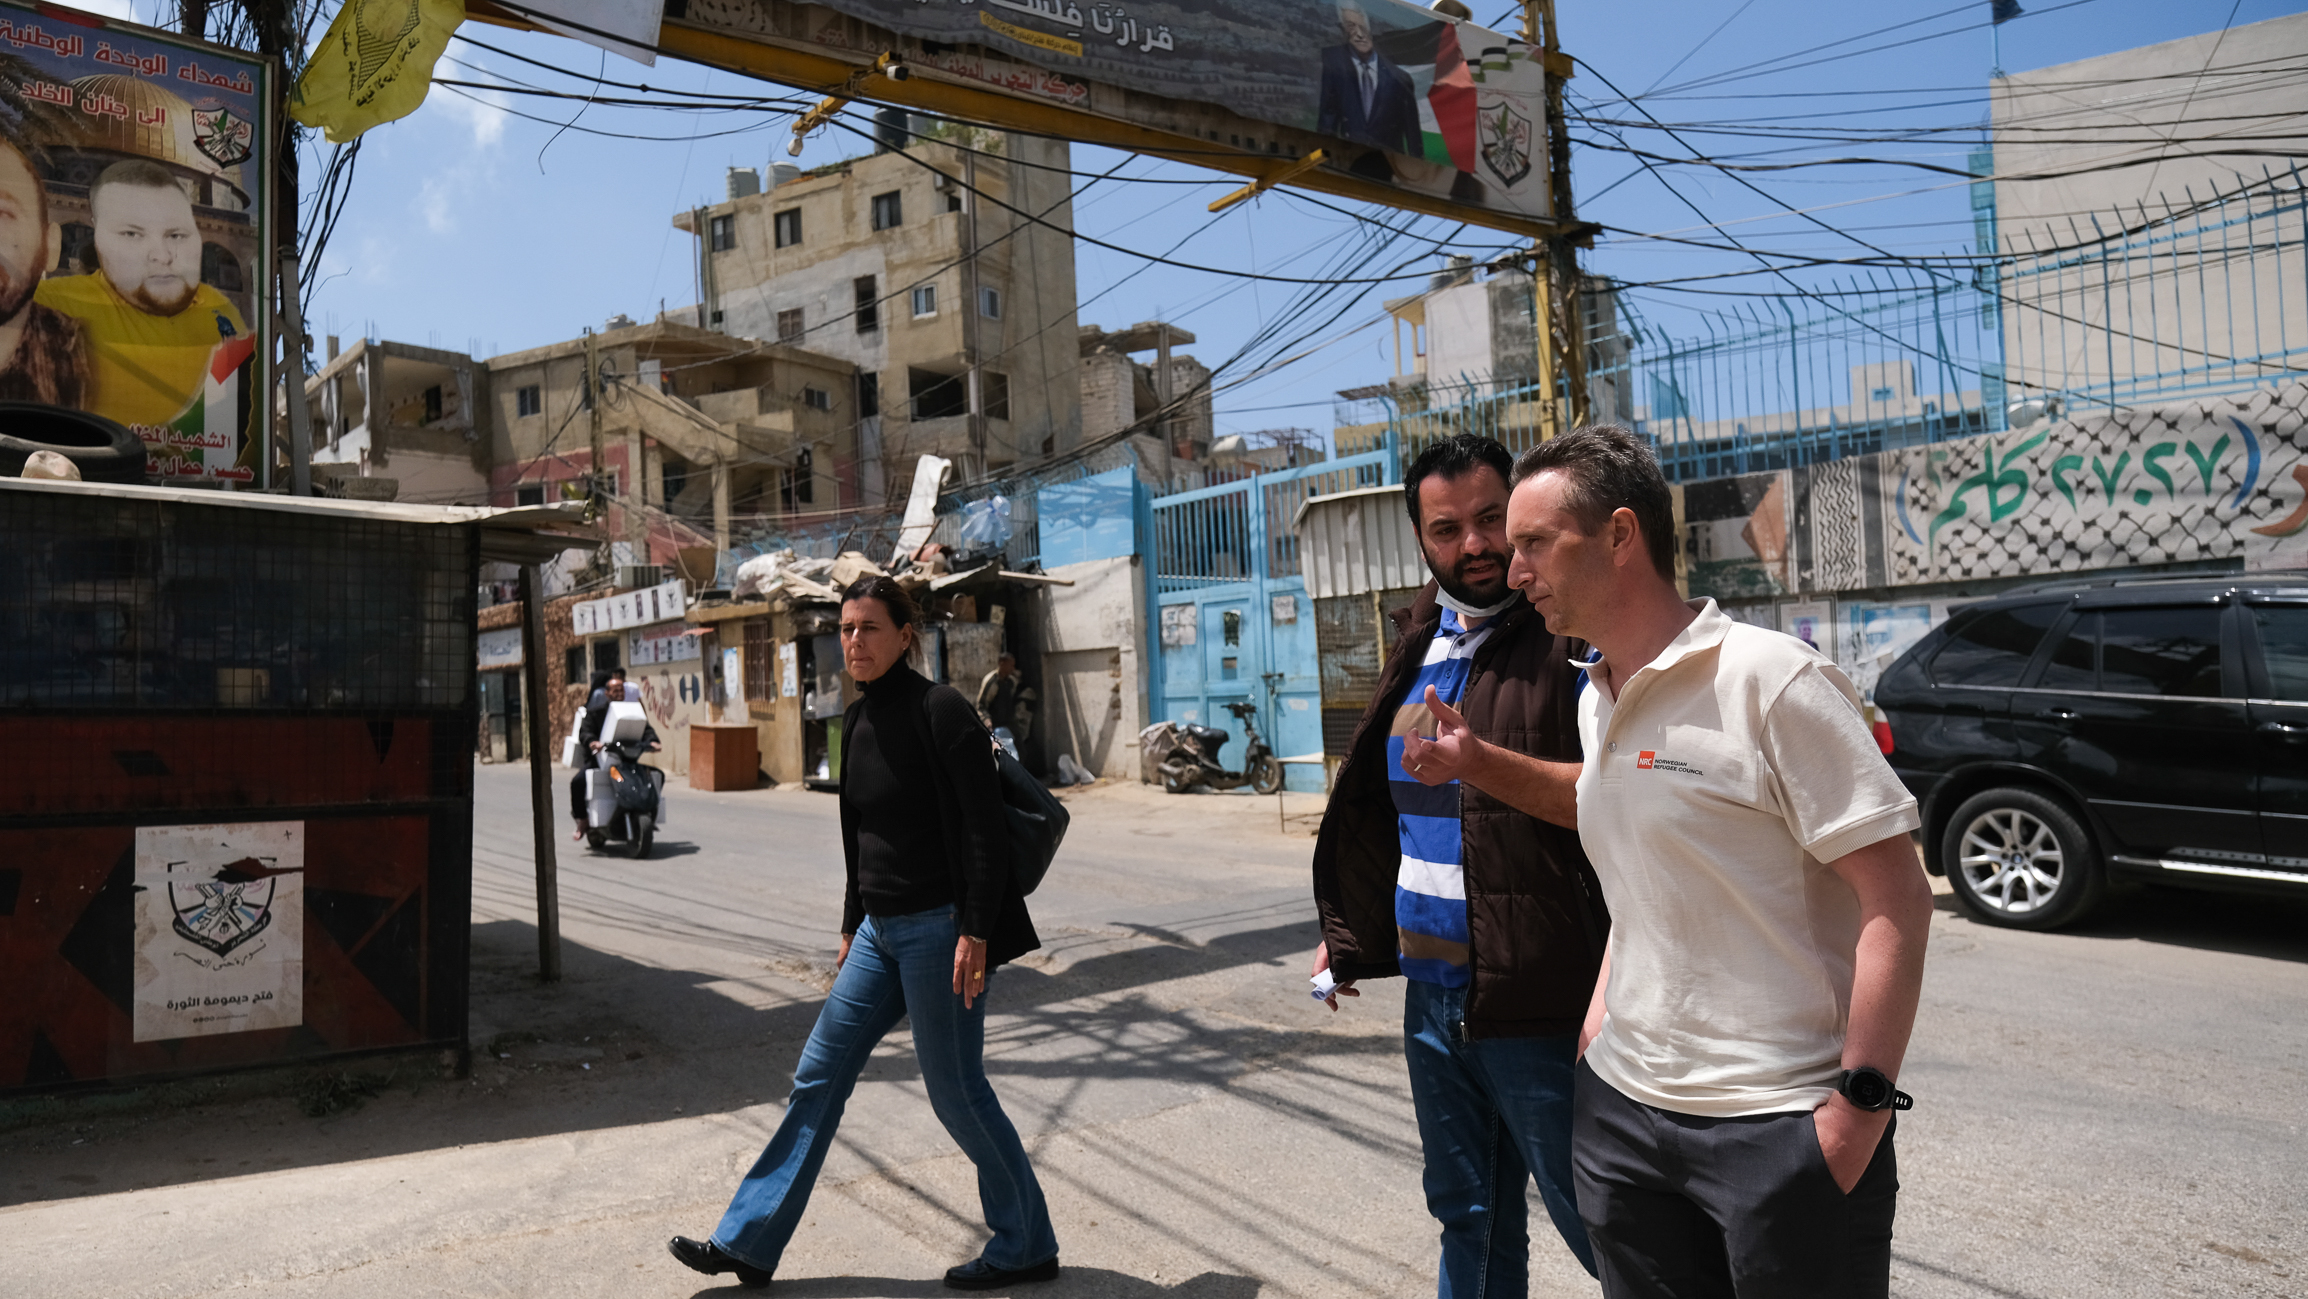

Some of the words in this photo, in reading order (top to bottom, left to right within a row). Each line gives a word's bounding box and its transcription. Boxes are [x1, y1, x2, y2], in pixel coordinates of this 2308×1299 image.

[0, 18, 83, 57] الوطنية
[94, 42, 168, 75] الوحدة
[178, 62, 253, 95] شهداء
[1041, 73, 1087, 103] حركة
[20, 81, 73, 107] الخلد
[81, 92, 129, 119] جنان
[168, 429, 231, 452] الشهيد
[1638, 757, 1652, 766] NRC
[1653, 764, 1677, 772] REFUGEE
[1678, 767, 1704, 776] COUNCIL
[1654, 758, 1688, 767] NORWEGIAN
[166, 995, 201, 1012] الثورة
[203, 994, 249, 1007] ديمومة
[252, 990, 274, 1005] فتح
